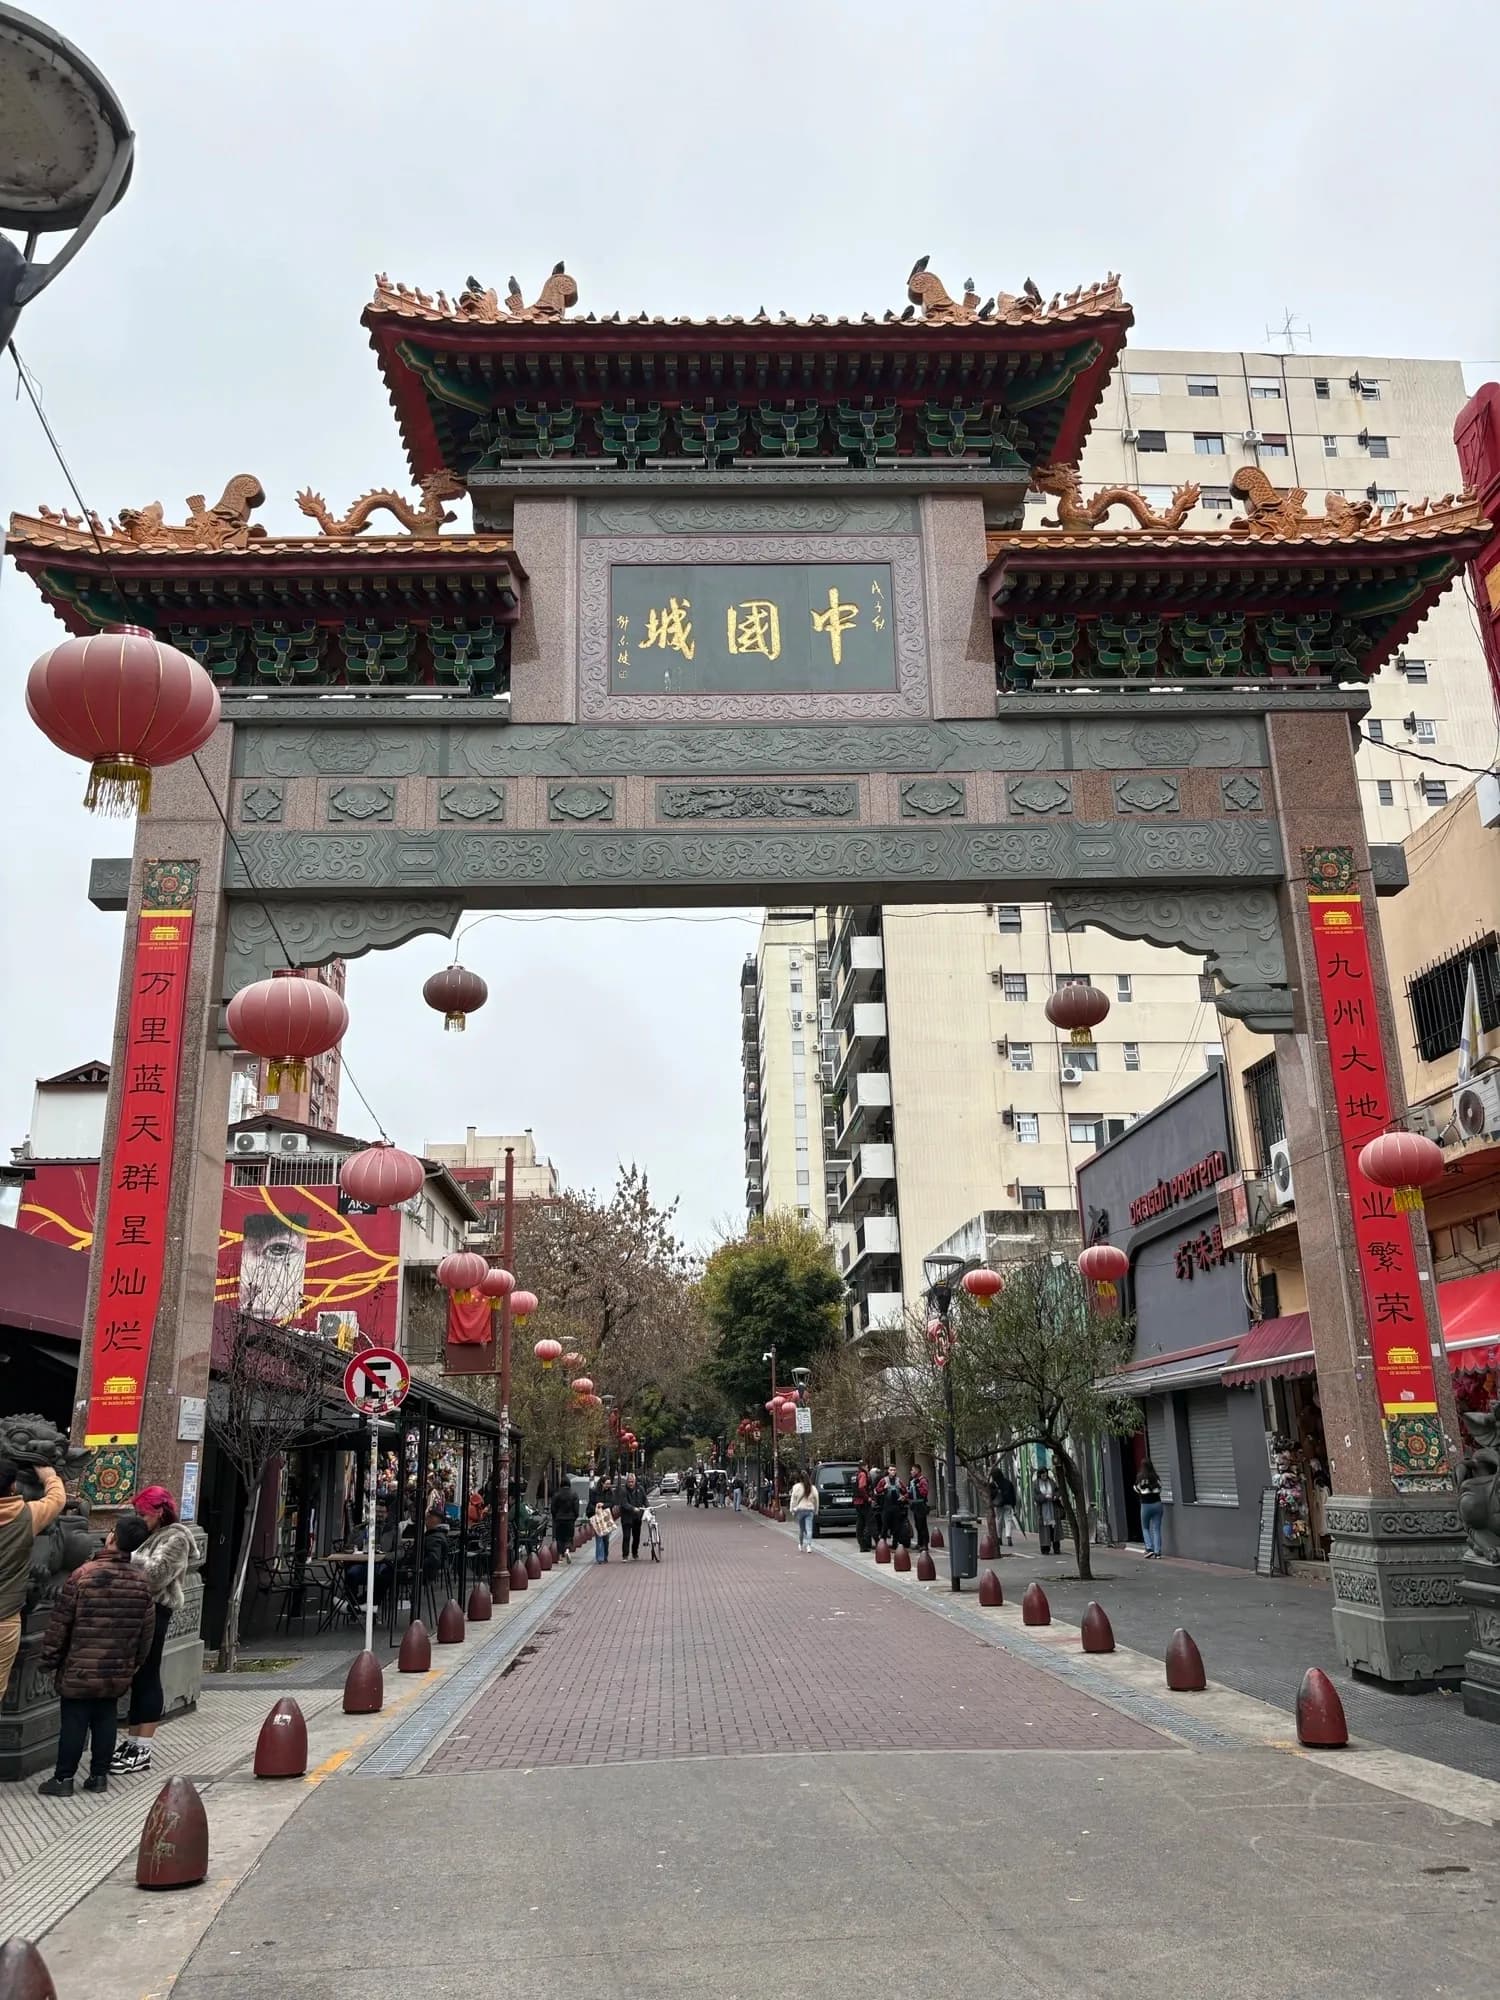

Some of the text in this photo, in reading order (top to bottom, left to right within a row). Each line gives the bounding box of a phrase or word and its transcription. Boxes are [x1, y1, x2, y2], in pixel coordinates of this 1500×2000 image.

[638, 586, 859, 665] 中國城
[101, 971, 176, 1352] 万里蓝天群星灿烂
[1326, 952, 1415, 1324] 九州大地业繁荣
